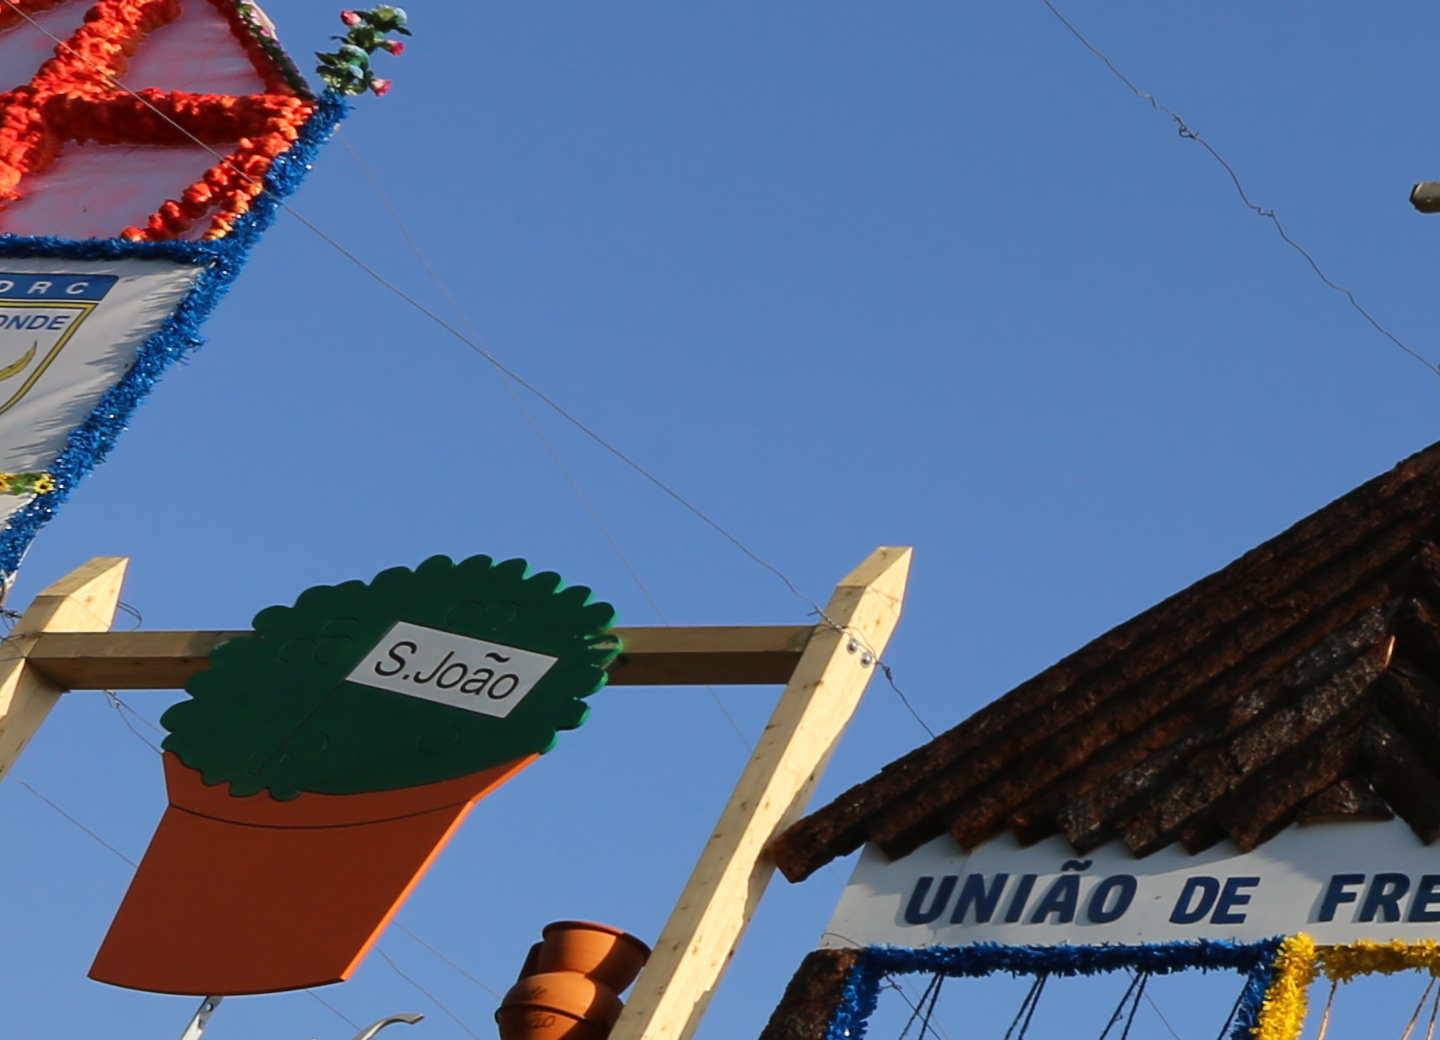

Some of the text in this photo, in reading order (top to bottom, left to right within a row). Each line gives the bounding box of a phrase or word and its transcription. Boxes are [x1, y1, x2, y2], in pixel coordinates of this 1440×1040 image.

[374, 641, 519, 700] S.João
[903, 859, 1138, 925] UNIÃO
[1169, 876, 1261, 925] DE
